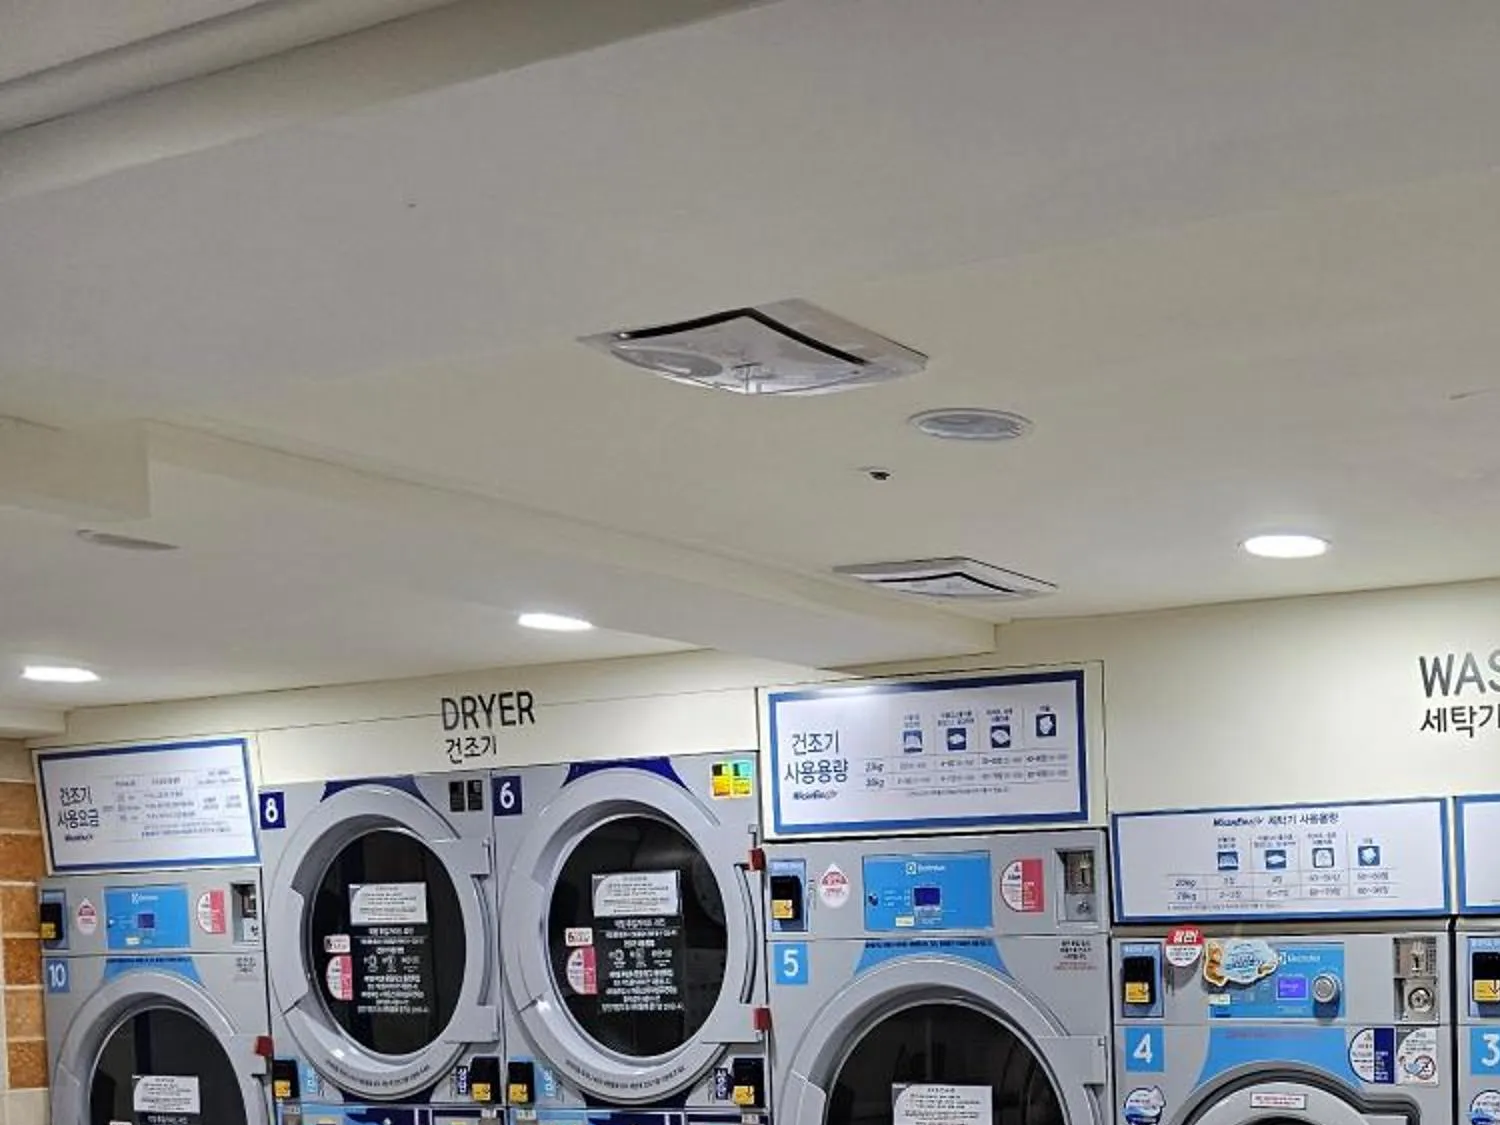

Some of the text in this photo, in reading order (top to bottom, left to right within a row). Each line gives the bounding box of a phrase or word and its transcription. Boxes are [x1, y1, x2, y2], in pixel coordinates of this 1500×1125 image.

[441, 691, 535, 730] DRYER
[445, 735, 497, 764] 건조기
[791, 729, 840, 754] 건조기
[784, 760, 848, 785] 사용용량
[60, 786, 93, 807] 건조기
[500, 781, 515, 809] 6
[266, 797, 278, 823] 8
[48, 963, 66, 988] 10
[784, 950, 798, 977] 5
[1132, 1033, 1153, 1063] 4
[1481, 1034, 1500, 1067] 3
